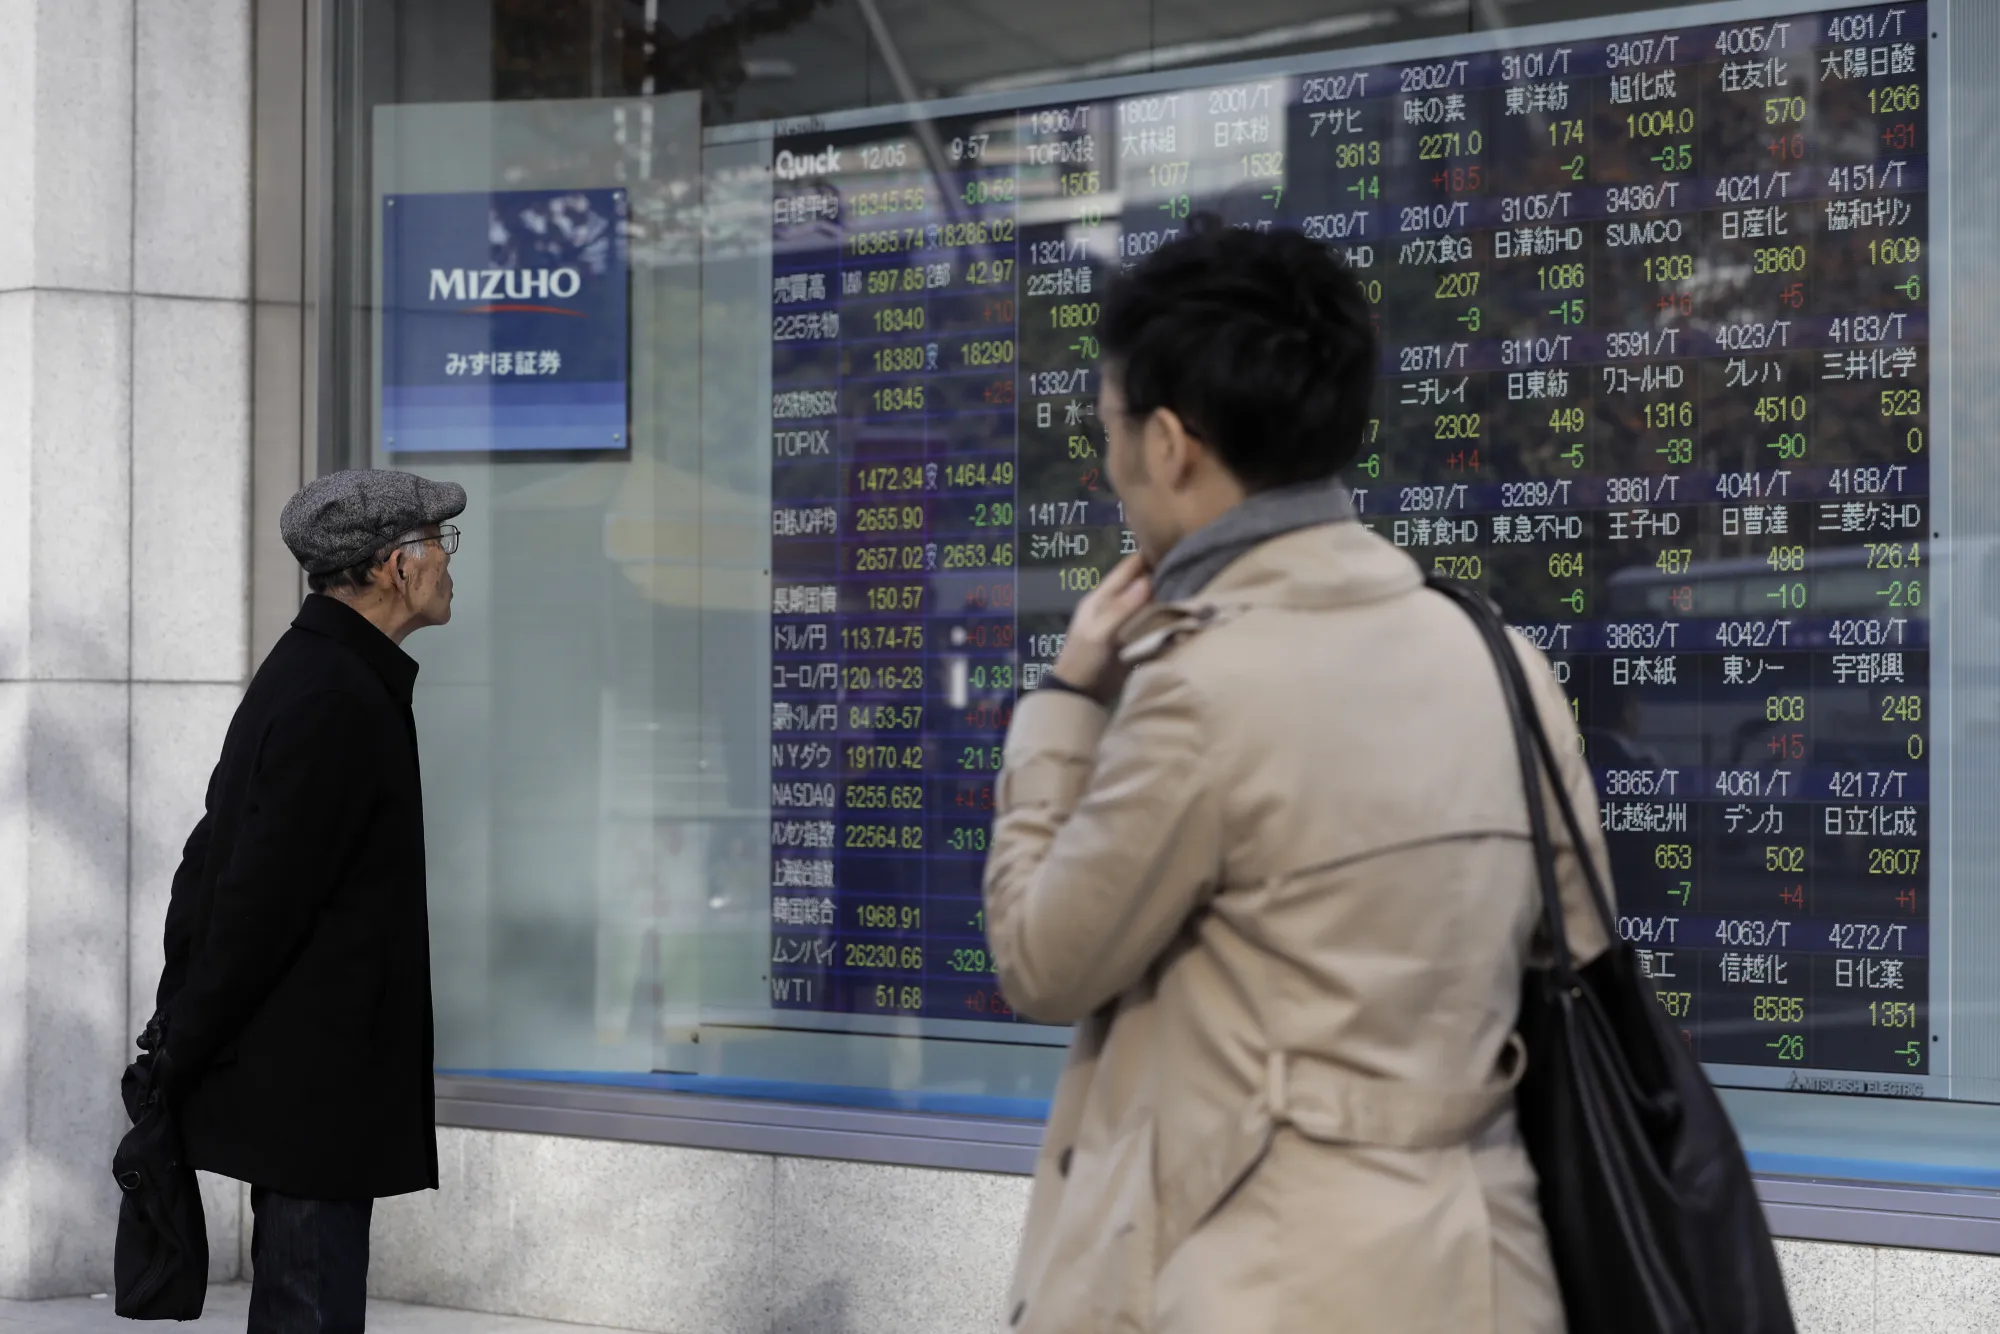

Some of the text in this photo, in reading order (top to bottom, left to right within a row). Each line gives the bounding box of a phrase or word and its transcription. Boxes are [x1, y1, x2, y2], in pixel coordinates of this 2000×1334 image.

[1501, 48, 1572, 81] 3101/T
[1606, 35, 1679, 69] 3407/T
[1821, 42, 1916, 82] 大陽日酸
[1302, 71, 1369, 103] 2502/T
[1400, 59, 1469, 93] 2802/T
[1610, 69, 1676, 104] 旭化成
[1719, 57, 1787, 92] 住友化
[1404, 93, 1466, 125] 味の素
[1505, 81, 1569, 116] 東洋紡
[1766, 96, 1806, 124] 570
[1868, 84, 1920, 114] 1266
[1215, 119, 1268, 148] 日本粉
[1309, 107, 1363, 137] アサヒ
[1549, 119, 1584, 146] 174
[1122, 125, 1176, 158] 大林組
[1336, 141, 1380, 169] 3613
[1419, 130, 1482, 160] 2271.0
[776, 135, 989, 179] Quick 12/05 9:57
[1560, 155, 1584, 180] -2
[1650, 144, 1692, 172] -3.5
[1347, 175, 1379, 200] -14
[1716, 171, 1791, 203] 4021/T
[1828, 160, 1907, 193] 4151/T
[1158, 195, 1190, 219] -13
[1262, 185, 1283, 209] -7
[1501, 190, 1572, 223] 3105/T
[1606, 180, 1679, 213] 3436/T
[1400, 201, 1469, 231] 2810/T
[1723, 205, 1787, 239] 日産化
[1495, 226, 1582, 259] 日清紡HD
[1606, 219, 1682, 247] SUMCO
[1029, 238, 1090, 265] 1321/T
[1399, 234, 1472, 265] ハウス食G
[1754, 246, 1806, 274] 3860
[868, 267, 925, 293] 597.85
[1027, 267, 1092, 296] 225投信
[1538, 263, 1584, 290] 1086
[1644, 255, 1692, 282] 1303
[429, 268, 581, 301] MIZUHO
[1435, 272, 1480, 299] 2207
[1894, 275, 1920, 300] -6
[774, 308, 925, 340] 225先物 18340
[1050, 302, 1100, 328] 18800
[1457, 307, 1480, 331] -3
[1549, 299, 1584, 324] -15
[1716, 320, 1791, 350] 4023/T
[1828, 312, 1907, 343] 4183/T
[1069, 336, 1099, 359] -70
[1401, 341, 1469, 371] 2871/T
[1502, 334, 1572, 365] 3110/T
[1606, 327, 1679, 357] 3591/T
[445, 350, 561, 376] みずほ証券
[873, 341, 1013, 372] 18380 18290
[1822, 347, 1917, 380] 三井化学
[1029, 368, 1089, 395] 1332/T
[1508, 369, 1569, 400] 日東紡
[1725, 358, 1781, 387] クレハ
[873, 387, 924, 411] 18345
[1401, 376, 1469, 405] ニチレイ
[1882, 389, 1921, 417] 523
[1549, 408, 1584, 433] 449
[1644, 402, 1692, 428] 1316
[1754, 396, 1806, 422] 4510
[1435, 414, 1480, 439] 2302
[1907, 427, 1922, 452] 0
[774, 430, 829, 456] TOPIX
[1561, 444, 1584, 468] -5
[1656, 439, 1692, 464] -33
[1767, 433, 1806, 459] -90
[858, 462, 1013, 491] 1472.34 1464.49
[1606, 474, 1679, 503] 3861/T
[1716, 470, 1791, 498] 4041/T
[1829, 464, 1907, 494] 4188/T
[1401, 483, 1468, 511] 2897/T
[1502, 479, 1572, 507] 3289/T
[857, 503, 1013, 531] 2655.90 -2.30
[1029, 500, 1088, 527] 1417/T
[1609, 509, 1680, 540] 王子HD
[1723, 505, 1788, 535] 日曹達
[1819, 502, 1921, 532] 三菱ケミHD
[1394, 517, 1478, 546] 日清食HD
[1492, 515, 1582, 543] 東急不HD
[857, 543, 1013, 570] 2657.02 2653.46
[1549, 553, 1584, 577] 664
[1656, 549, 1692, 574] 487
[1767, 546, 1804, 571] 498
[1864, 542, 1921, 569] 726.4
[867, 587, 923, 610] 150.57
[1561, 589, 1584, 613] -6
[1767, 583, 1806, 609] -10
[1876, 580, 1921, 607] -2.6
[842, 626, 924, 649] 113.74-75
[1606, 621, 1679, 648] 3863/T
[1716, 619, 1791, 647] 4042/T
[1829, 617, 1907, 646] 4208/T
[842, 666, 923, 689] 120.16-23
[969, 665, 1012, 688] -0.33
[1613, 655, 1676, 685] 日本紙
[1723, 655, 1784, 684] 東ソー
[1833, 653, 1904, 684] 宇部興
[850, 707, 923, 729] 84.53-57
[1766, 696, 1804, 721] 803
[1882, 696, 1921, 721] 248
[847, 747, 922, 769] 19170.42
[1908, 734, 1923, 759] 0
[773, 784, 922, 809] NASDAQ 5255.652
[1606, 769, 1679, 796] 3865/T
[1716, 770, 1791, 796] 4061/T
[1829, 770, 1907, 797] 4217/T
[1600, 802, 1687, 832] 北越紀州
[1725, 804, 1782, 834] デンカ
[1825, 805, 1917, 836] 日立化成
[846, 825, 922, 849] 22564.82
[1656, 844, 1691, 869] 653
[1766, 847, 1804, 872] 502
[1869, 849, 1921, 874] 2607
[1667, 882, 1691, 906] -7
[1779, 885, 1803, 909] +4
[857, 905, 921, 928] 1968.91
[1715, 920, 1791, 946] 4063/T
[1829, 923, 1907, 950] 4272/T
[773, 937, 922, 970] ムンバイ 26230.66
[1719, 953, 1787, 984] 信越化
[1836, 958, 1903, 989] 日化薬
[773, 979, 922, 1009] WTI 51.68
[1754, 996, 1804, 1022] 8585
[1869, 1001, 1915, 1028] 1351
[1766, 1035, 1804, 1060] -26
[1895, 1041, 1920, 1066] -5
[1802, 1075, 1924, 1097] MITSUBISHI ELECTRIC
